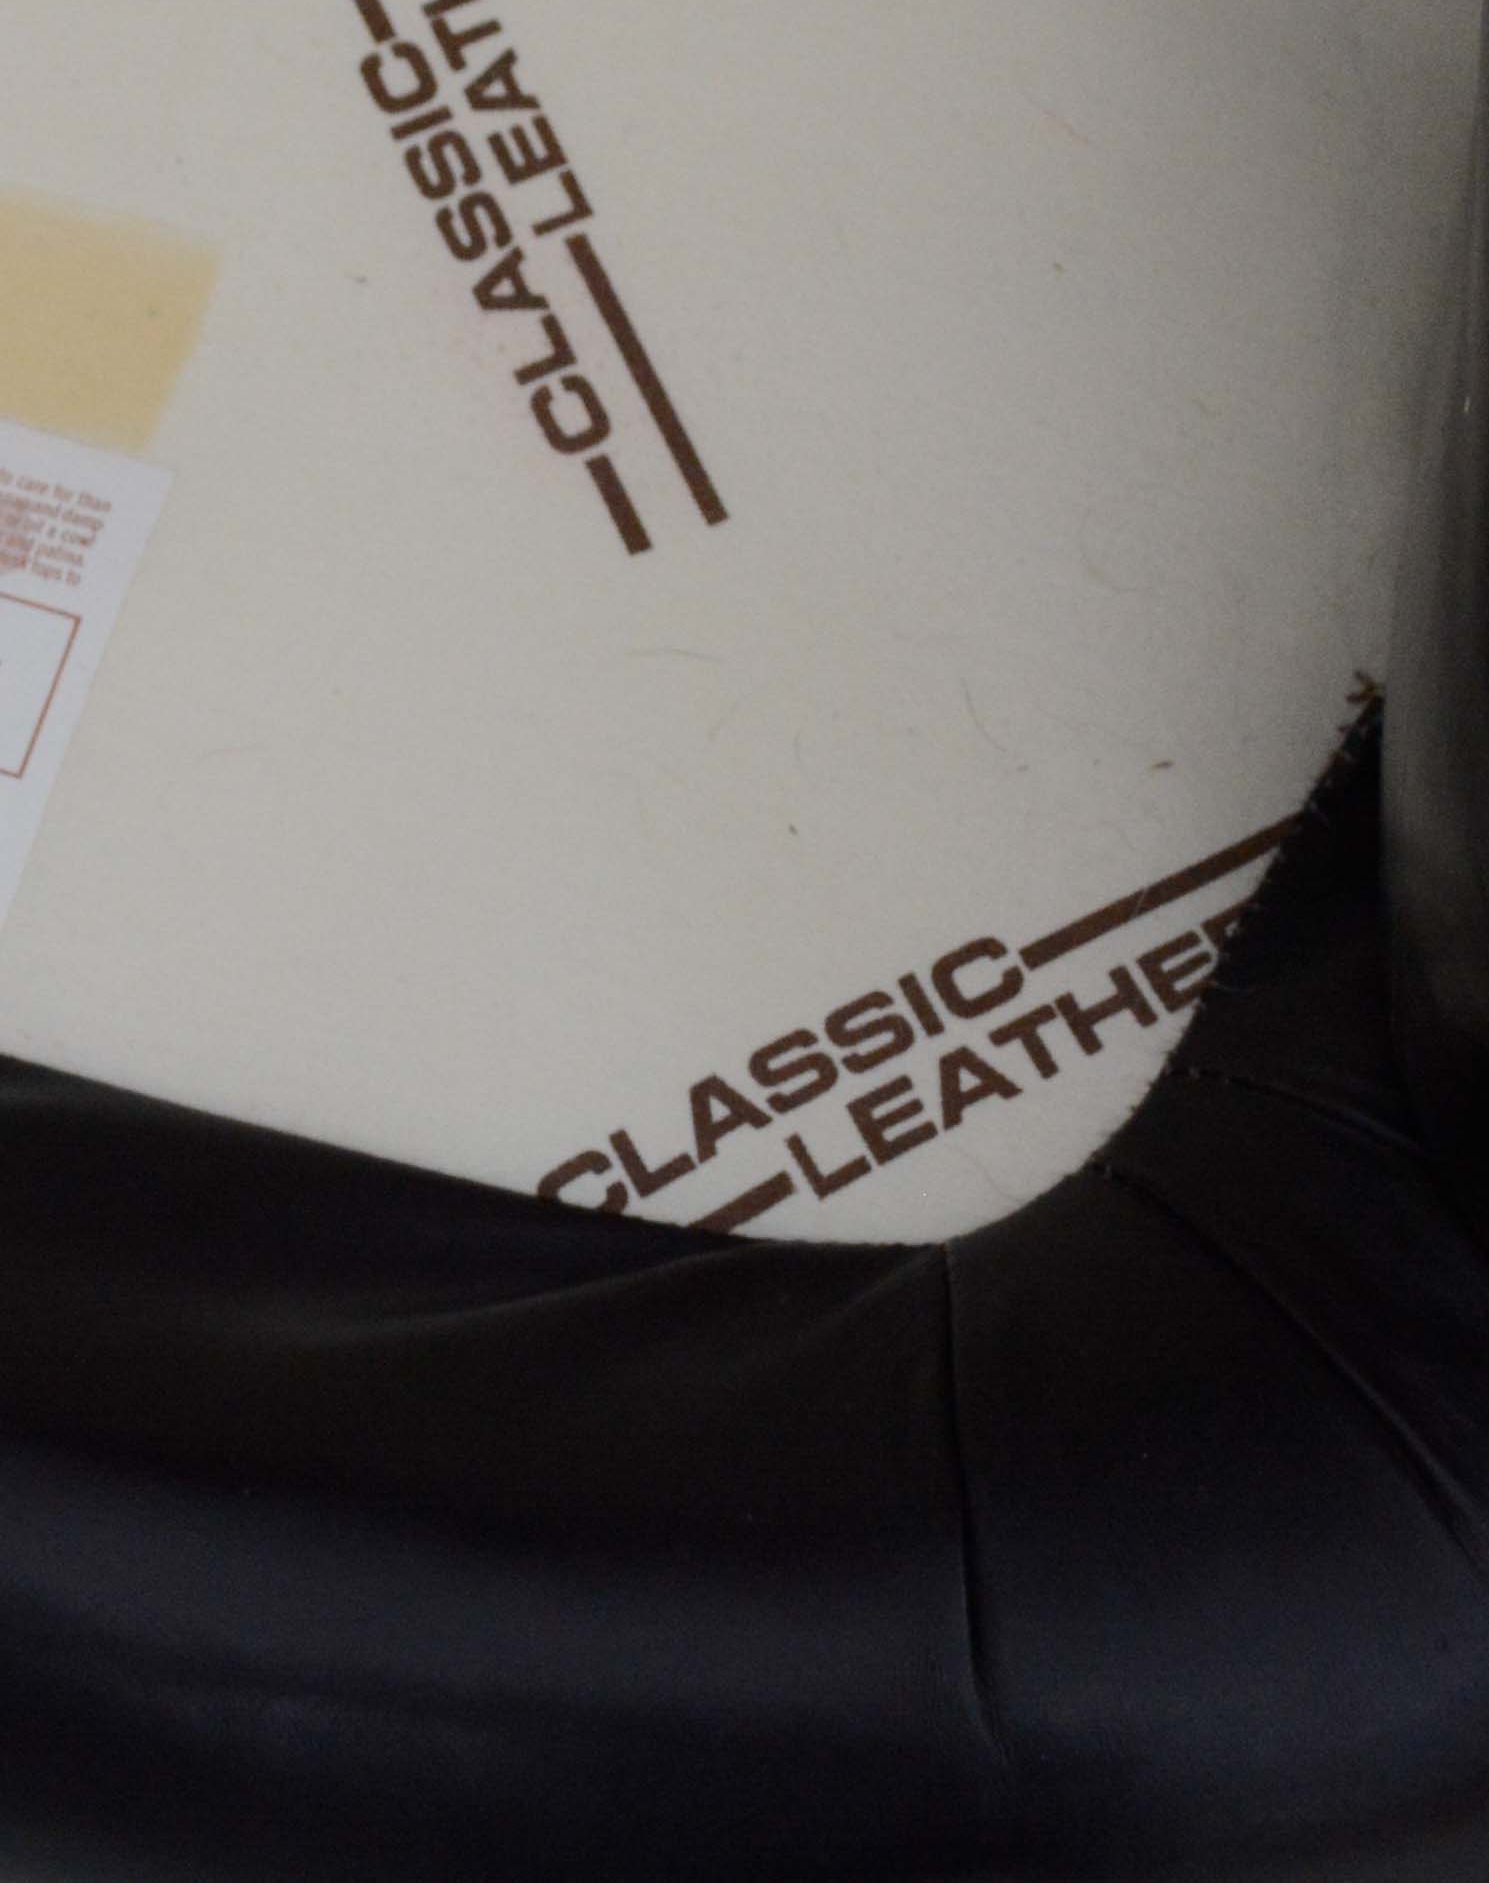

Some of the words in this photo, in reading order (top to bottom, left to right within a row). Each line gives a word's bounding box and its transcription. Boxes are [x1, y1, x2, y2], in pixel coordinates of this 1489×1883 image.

[358, 35, 612, 457] CLASSIC
[536, 935, 1027, 1217] CLASSIC
[784, 915, 1246, 1201] LEATHE
